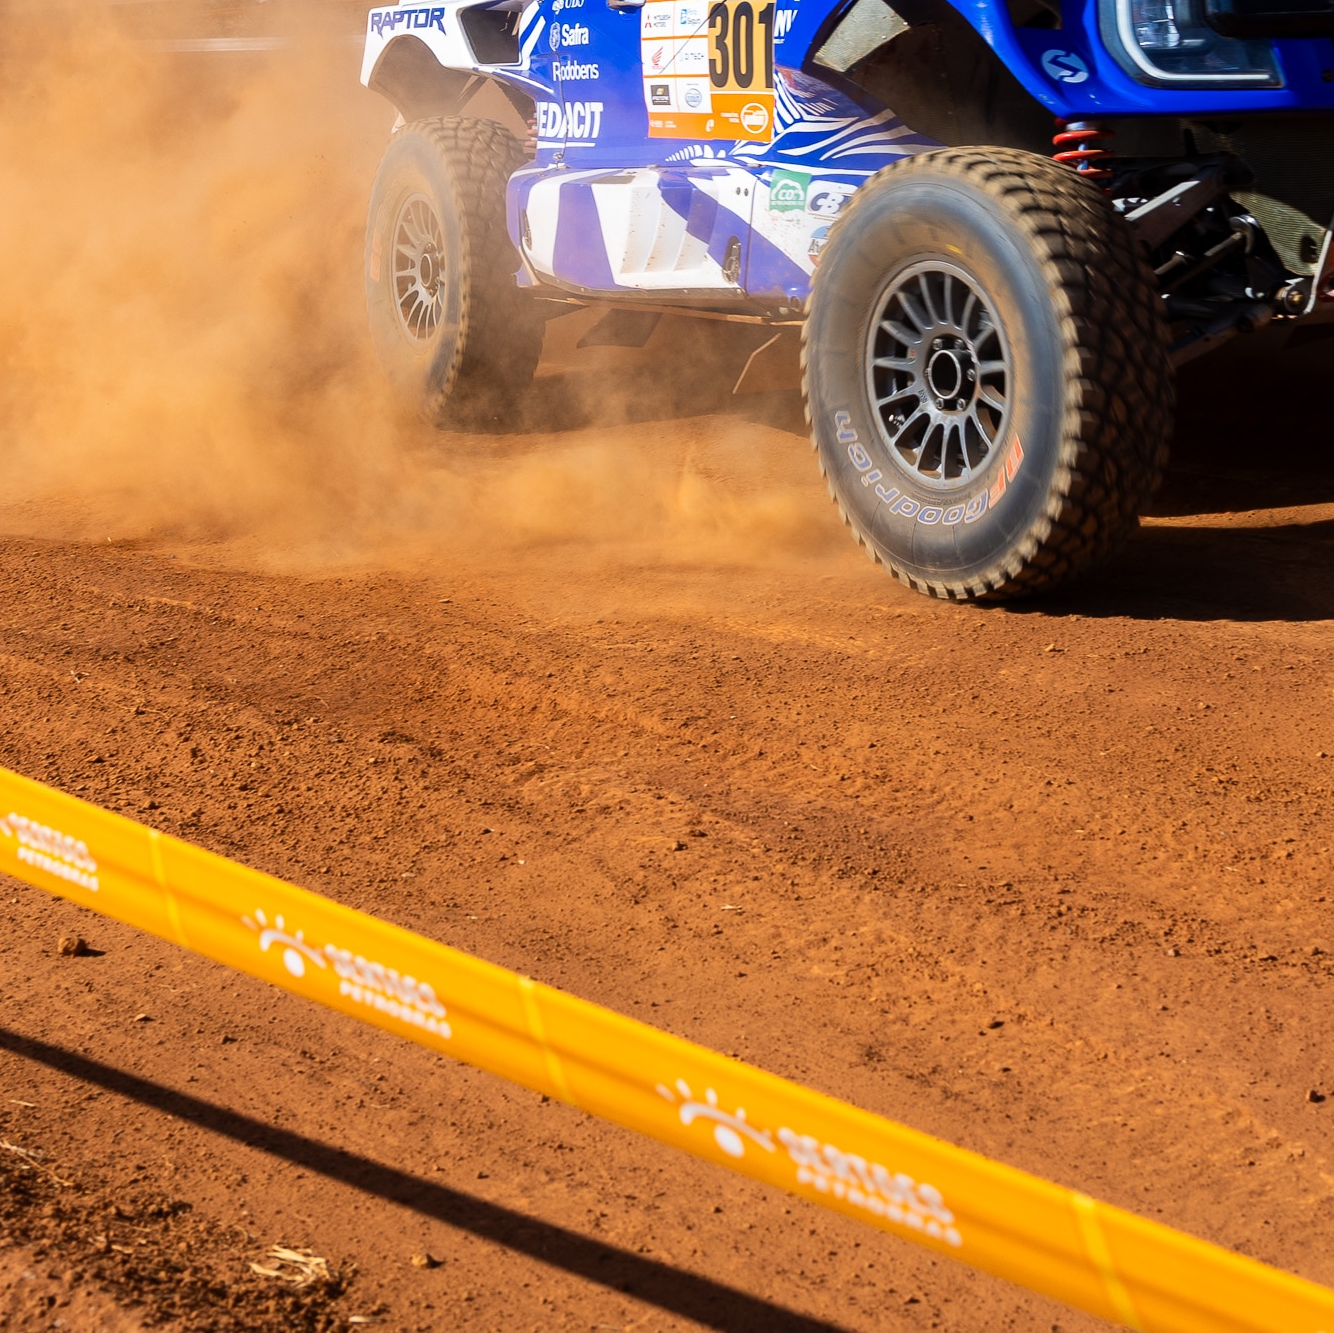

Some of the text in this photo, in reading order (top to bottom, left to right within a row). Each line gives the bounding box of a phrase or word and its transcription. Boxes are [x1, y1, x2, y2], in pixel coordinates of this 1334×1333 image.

[371, 7, 446, 39] RAPTOR
[562, 23, 589, 46] Safra
[709, 1, 774, 89] 301
[552, 61, 599, 81] Rodobens
[537, 101, 604, 139] EDACIT
